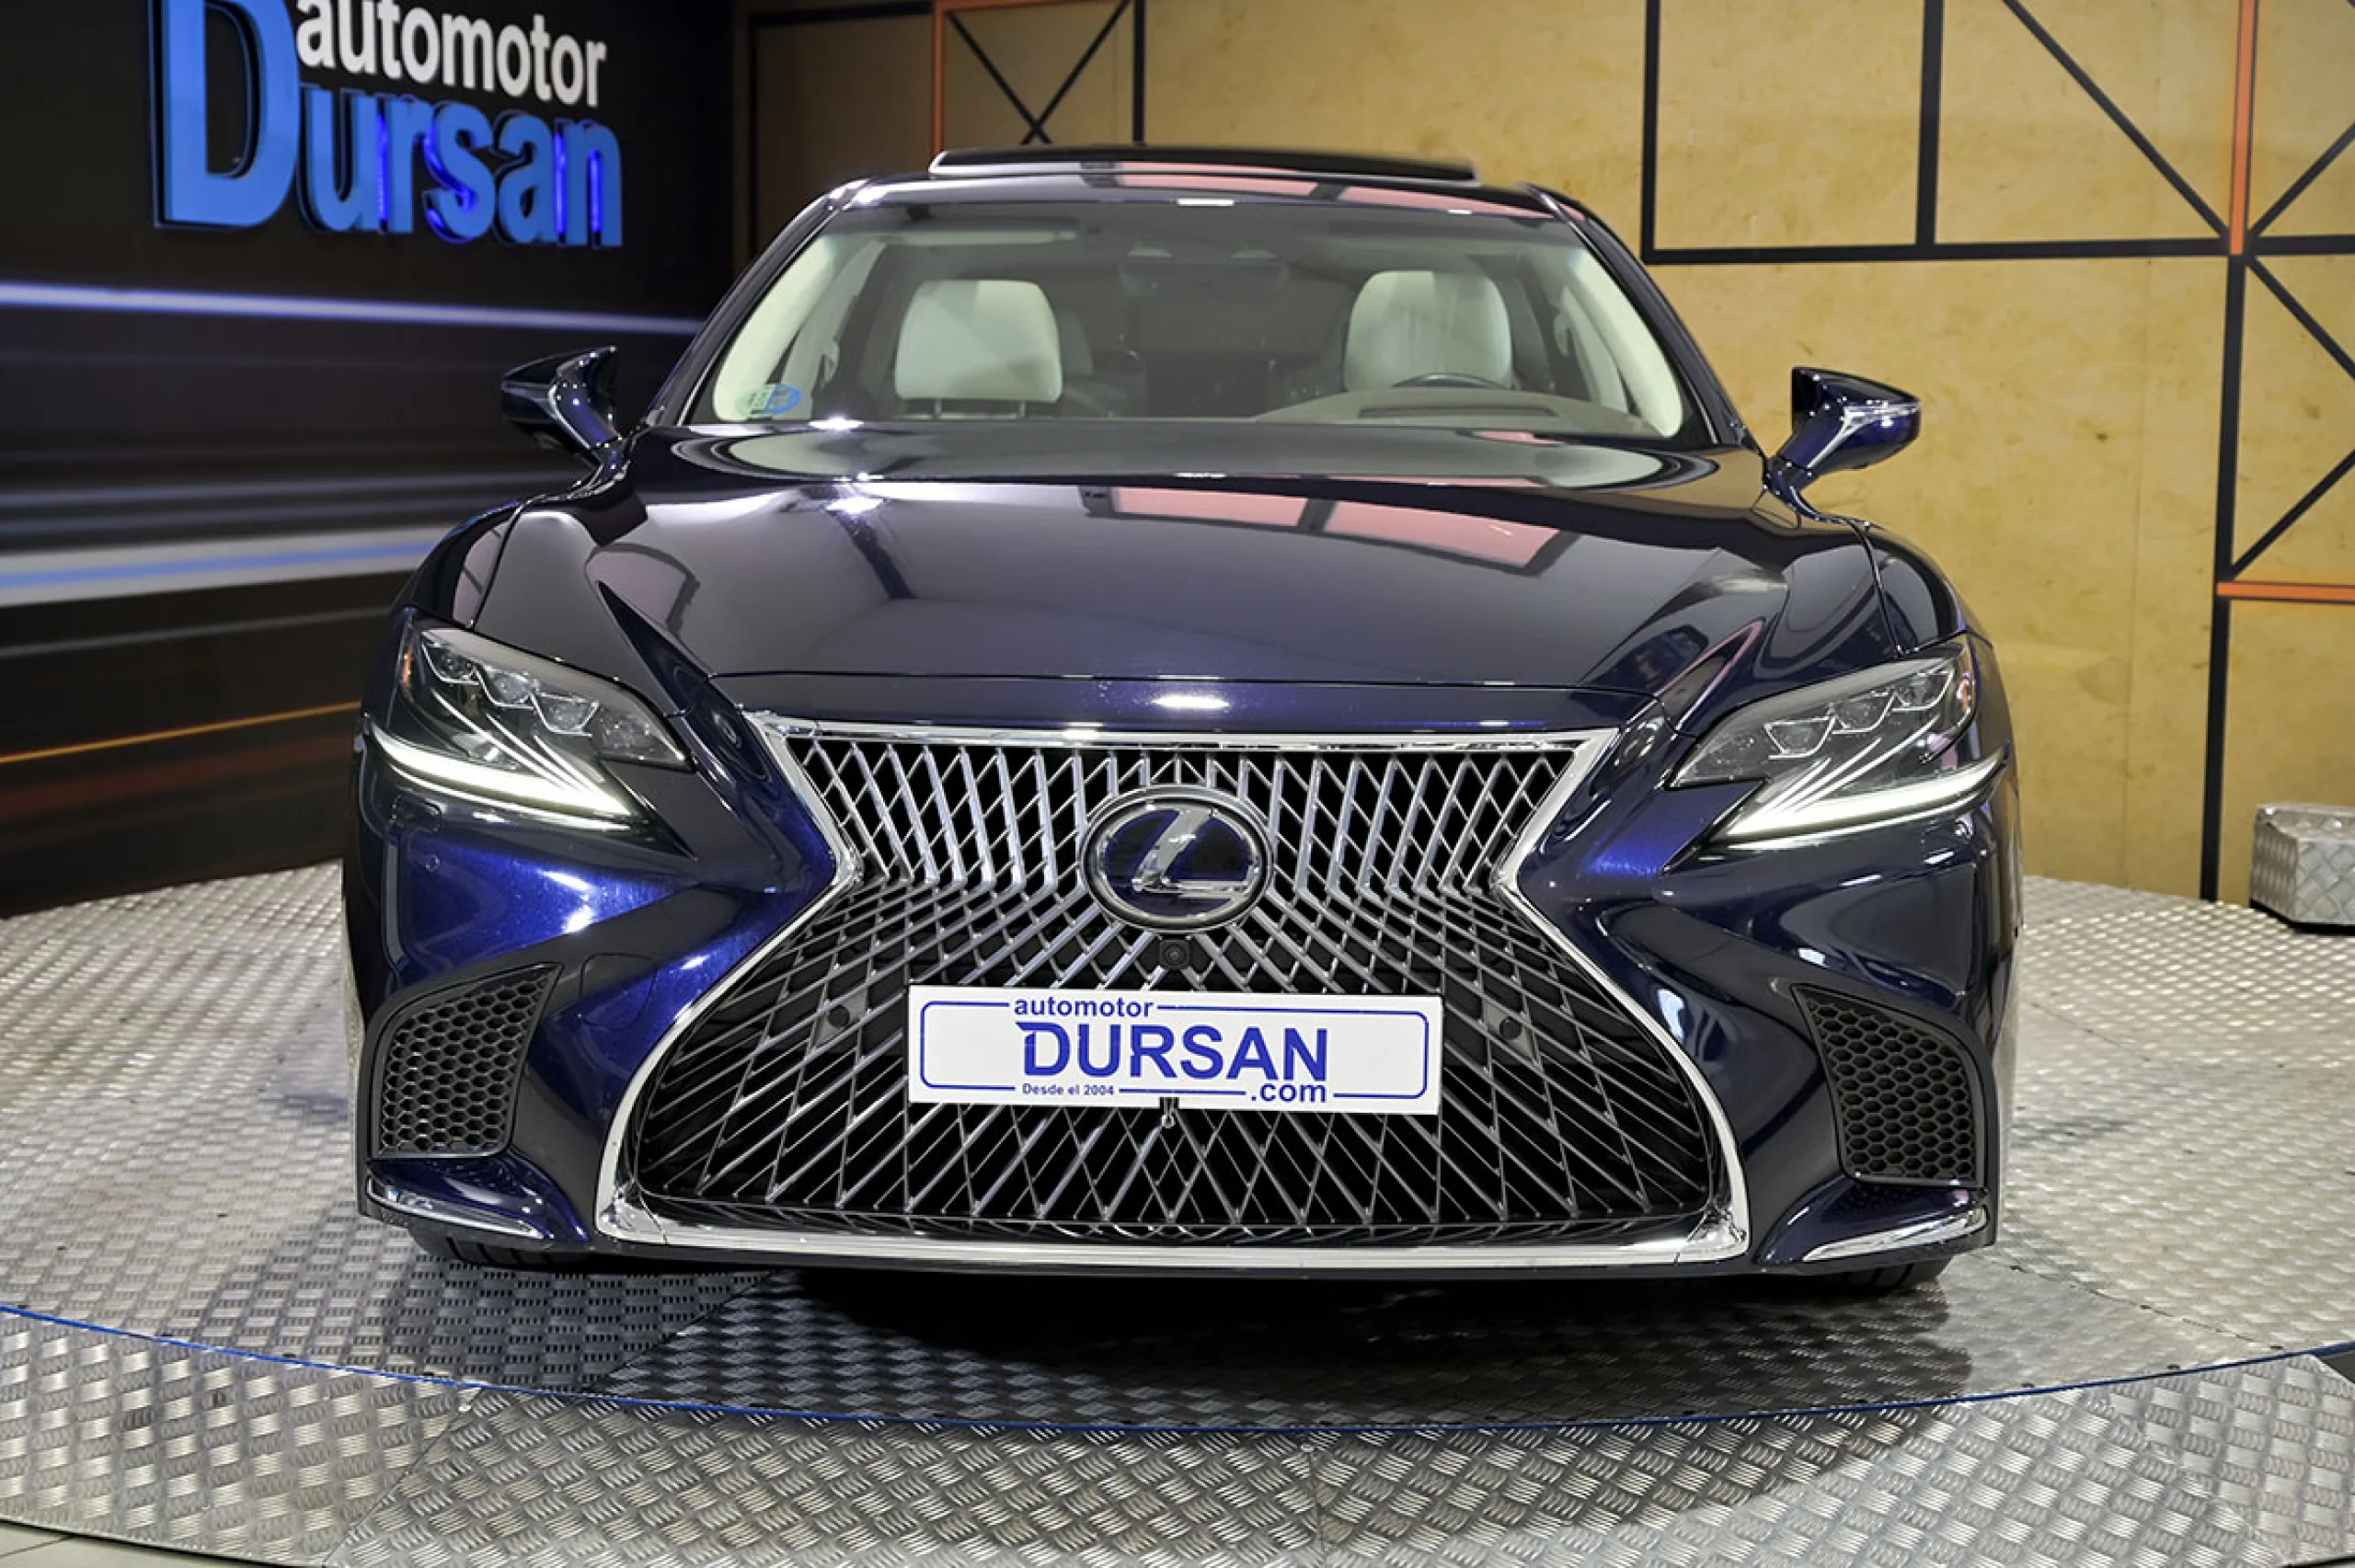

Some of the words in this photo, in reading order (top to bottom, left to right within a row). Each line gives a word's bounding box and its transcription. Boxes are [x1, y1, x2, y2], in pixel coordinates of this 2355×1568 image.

[295, 0, 607, 108] automotor
[150, 0, 624, 247] Dursan
[1014, 996, 1155, 1018] automotor
[1015, 1021, 1327, 1082] DURSAN
[1022, 1082, 1064, 1097] Desde
[1067, 1084, 1080, 1096] el
[1085, 1084, 1115, 1096] 2004
[1250, 1082, 1327, 1104] .com
